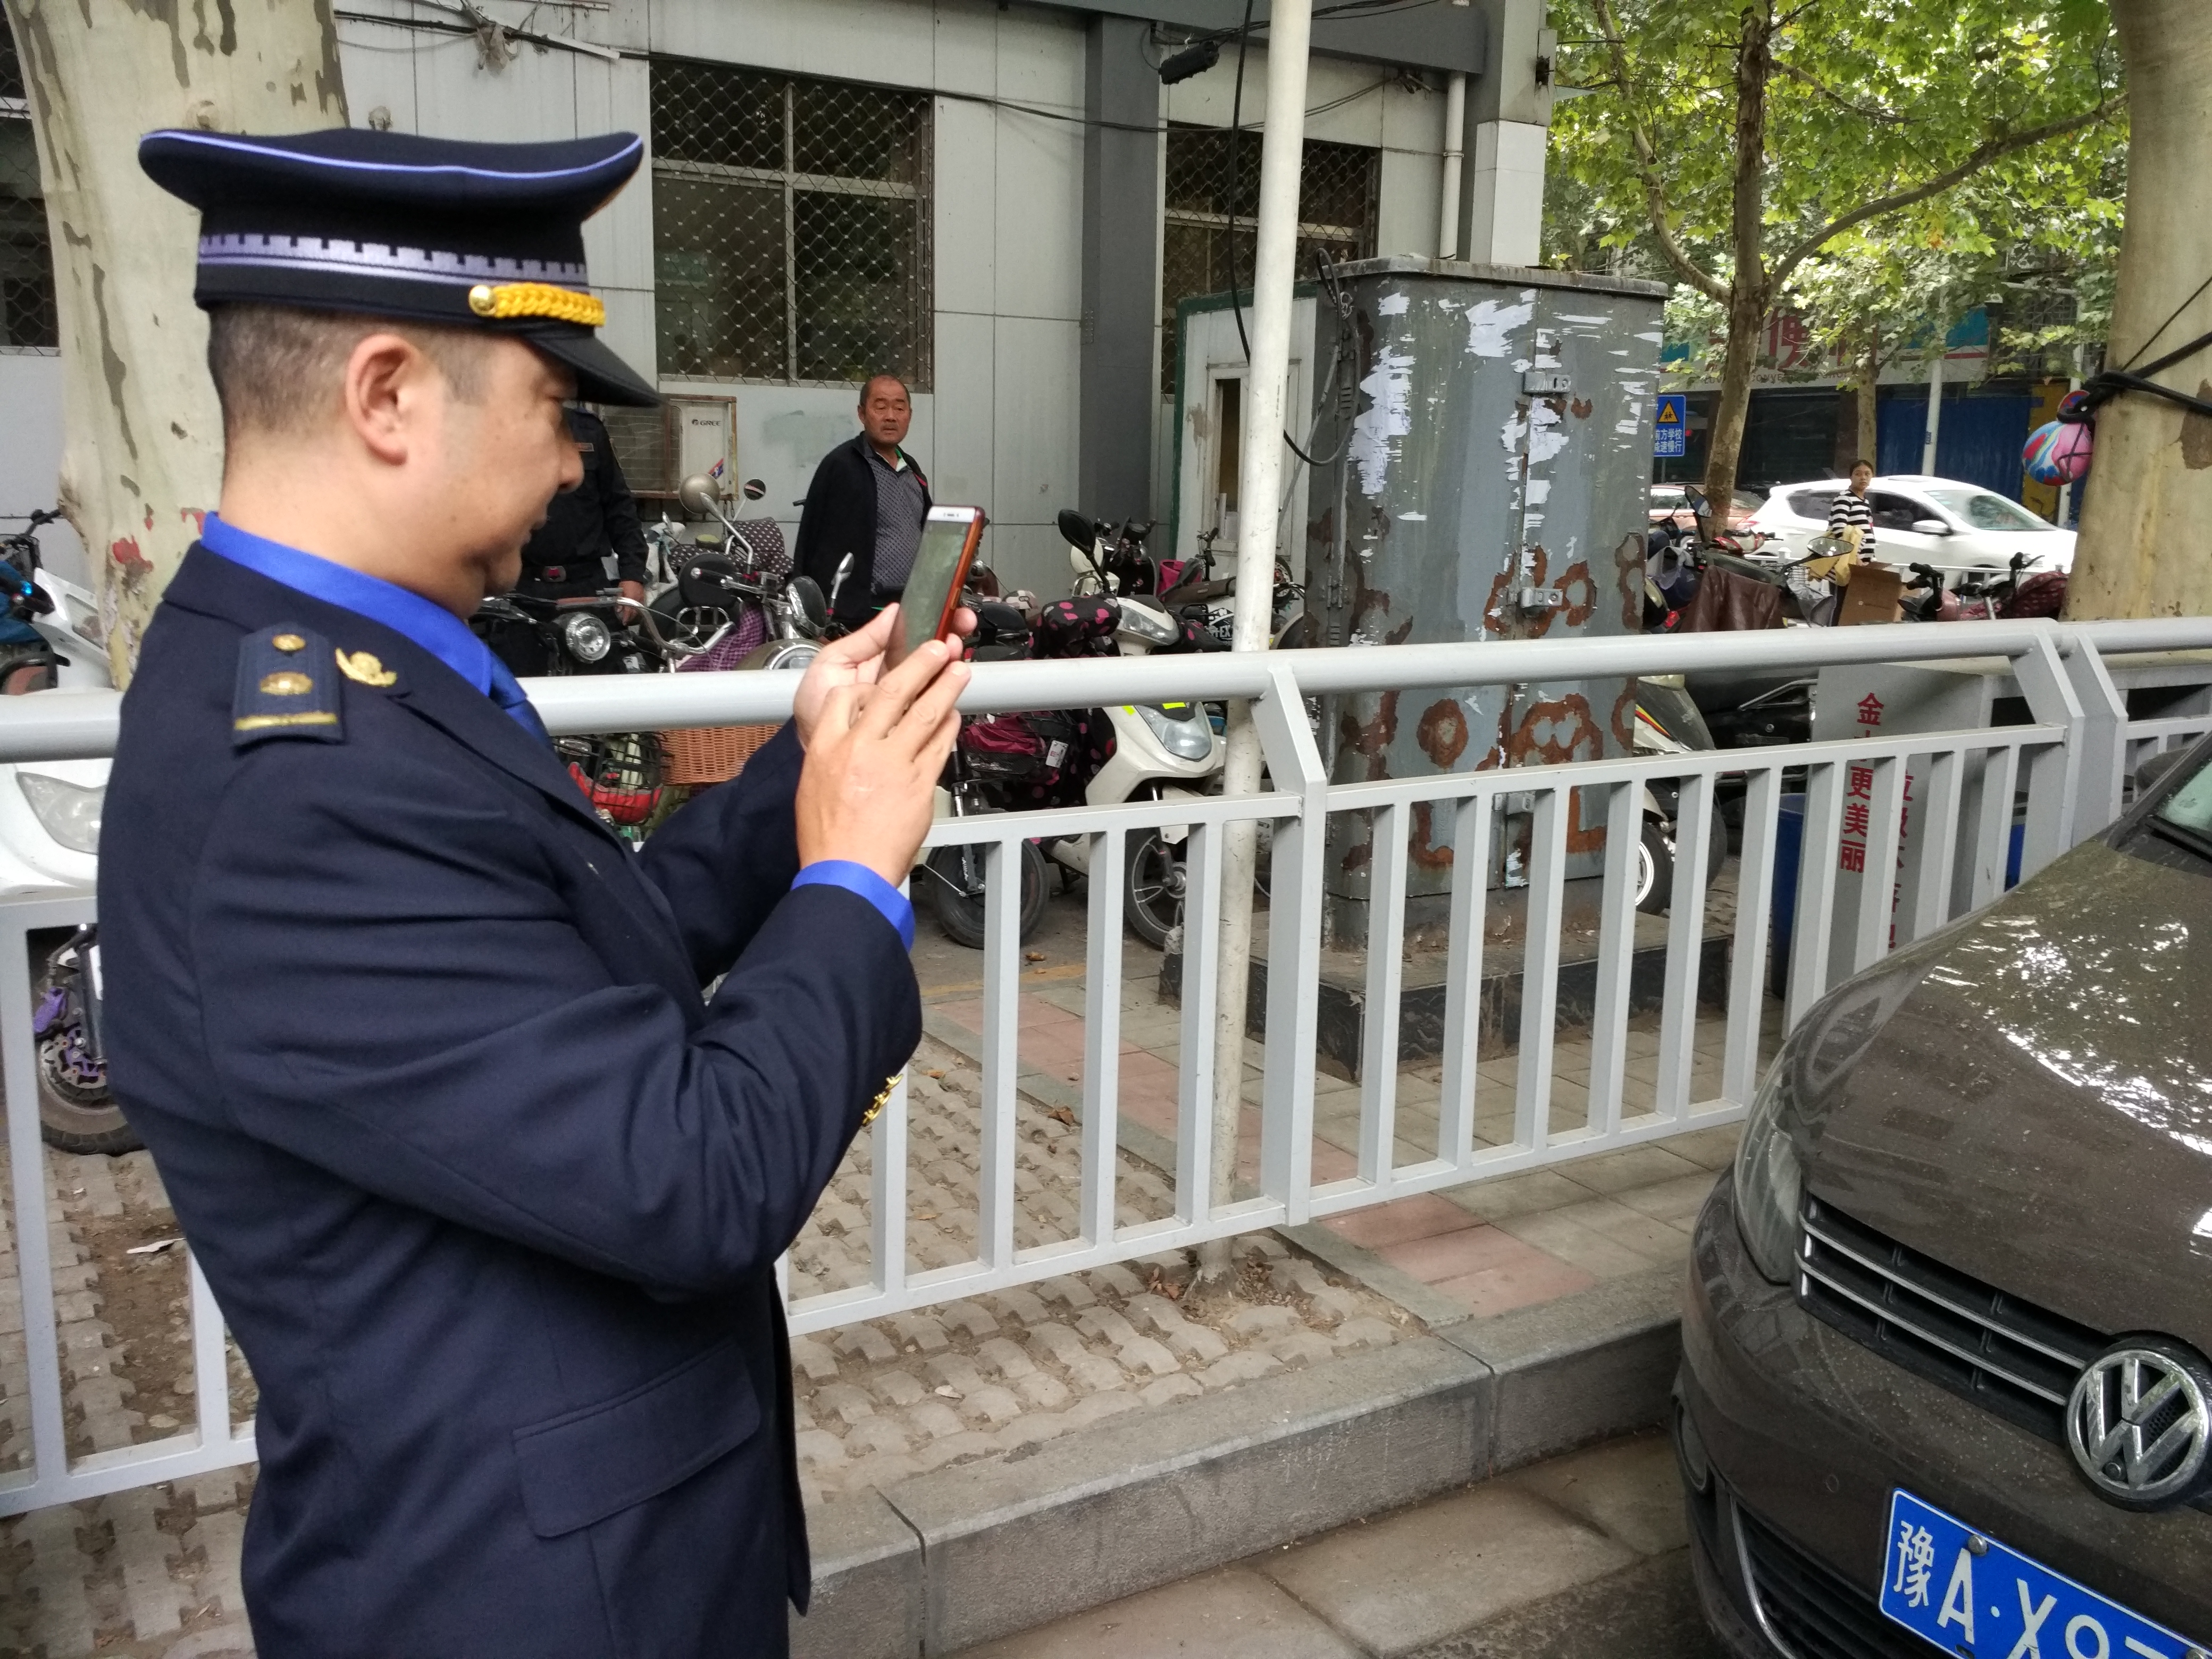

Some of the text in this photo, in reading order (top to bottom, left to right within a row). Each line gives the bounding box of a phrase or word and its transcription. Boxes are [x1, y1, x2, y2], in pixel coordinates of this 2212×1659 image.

[1655, 428, 1683, 441] 前方学校
[1840, 692, 1884, 874] 金更美丽
